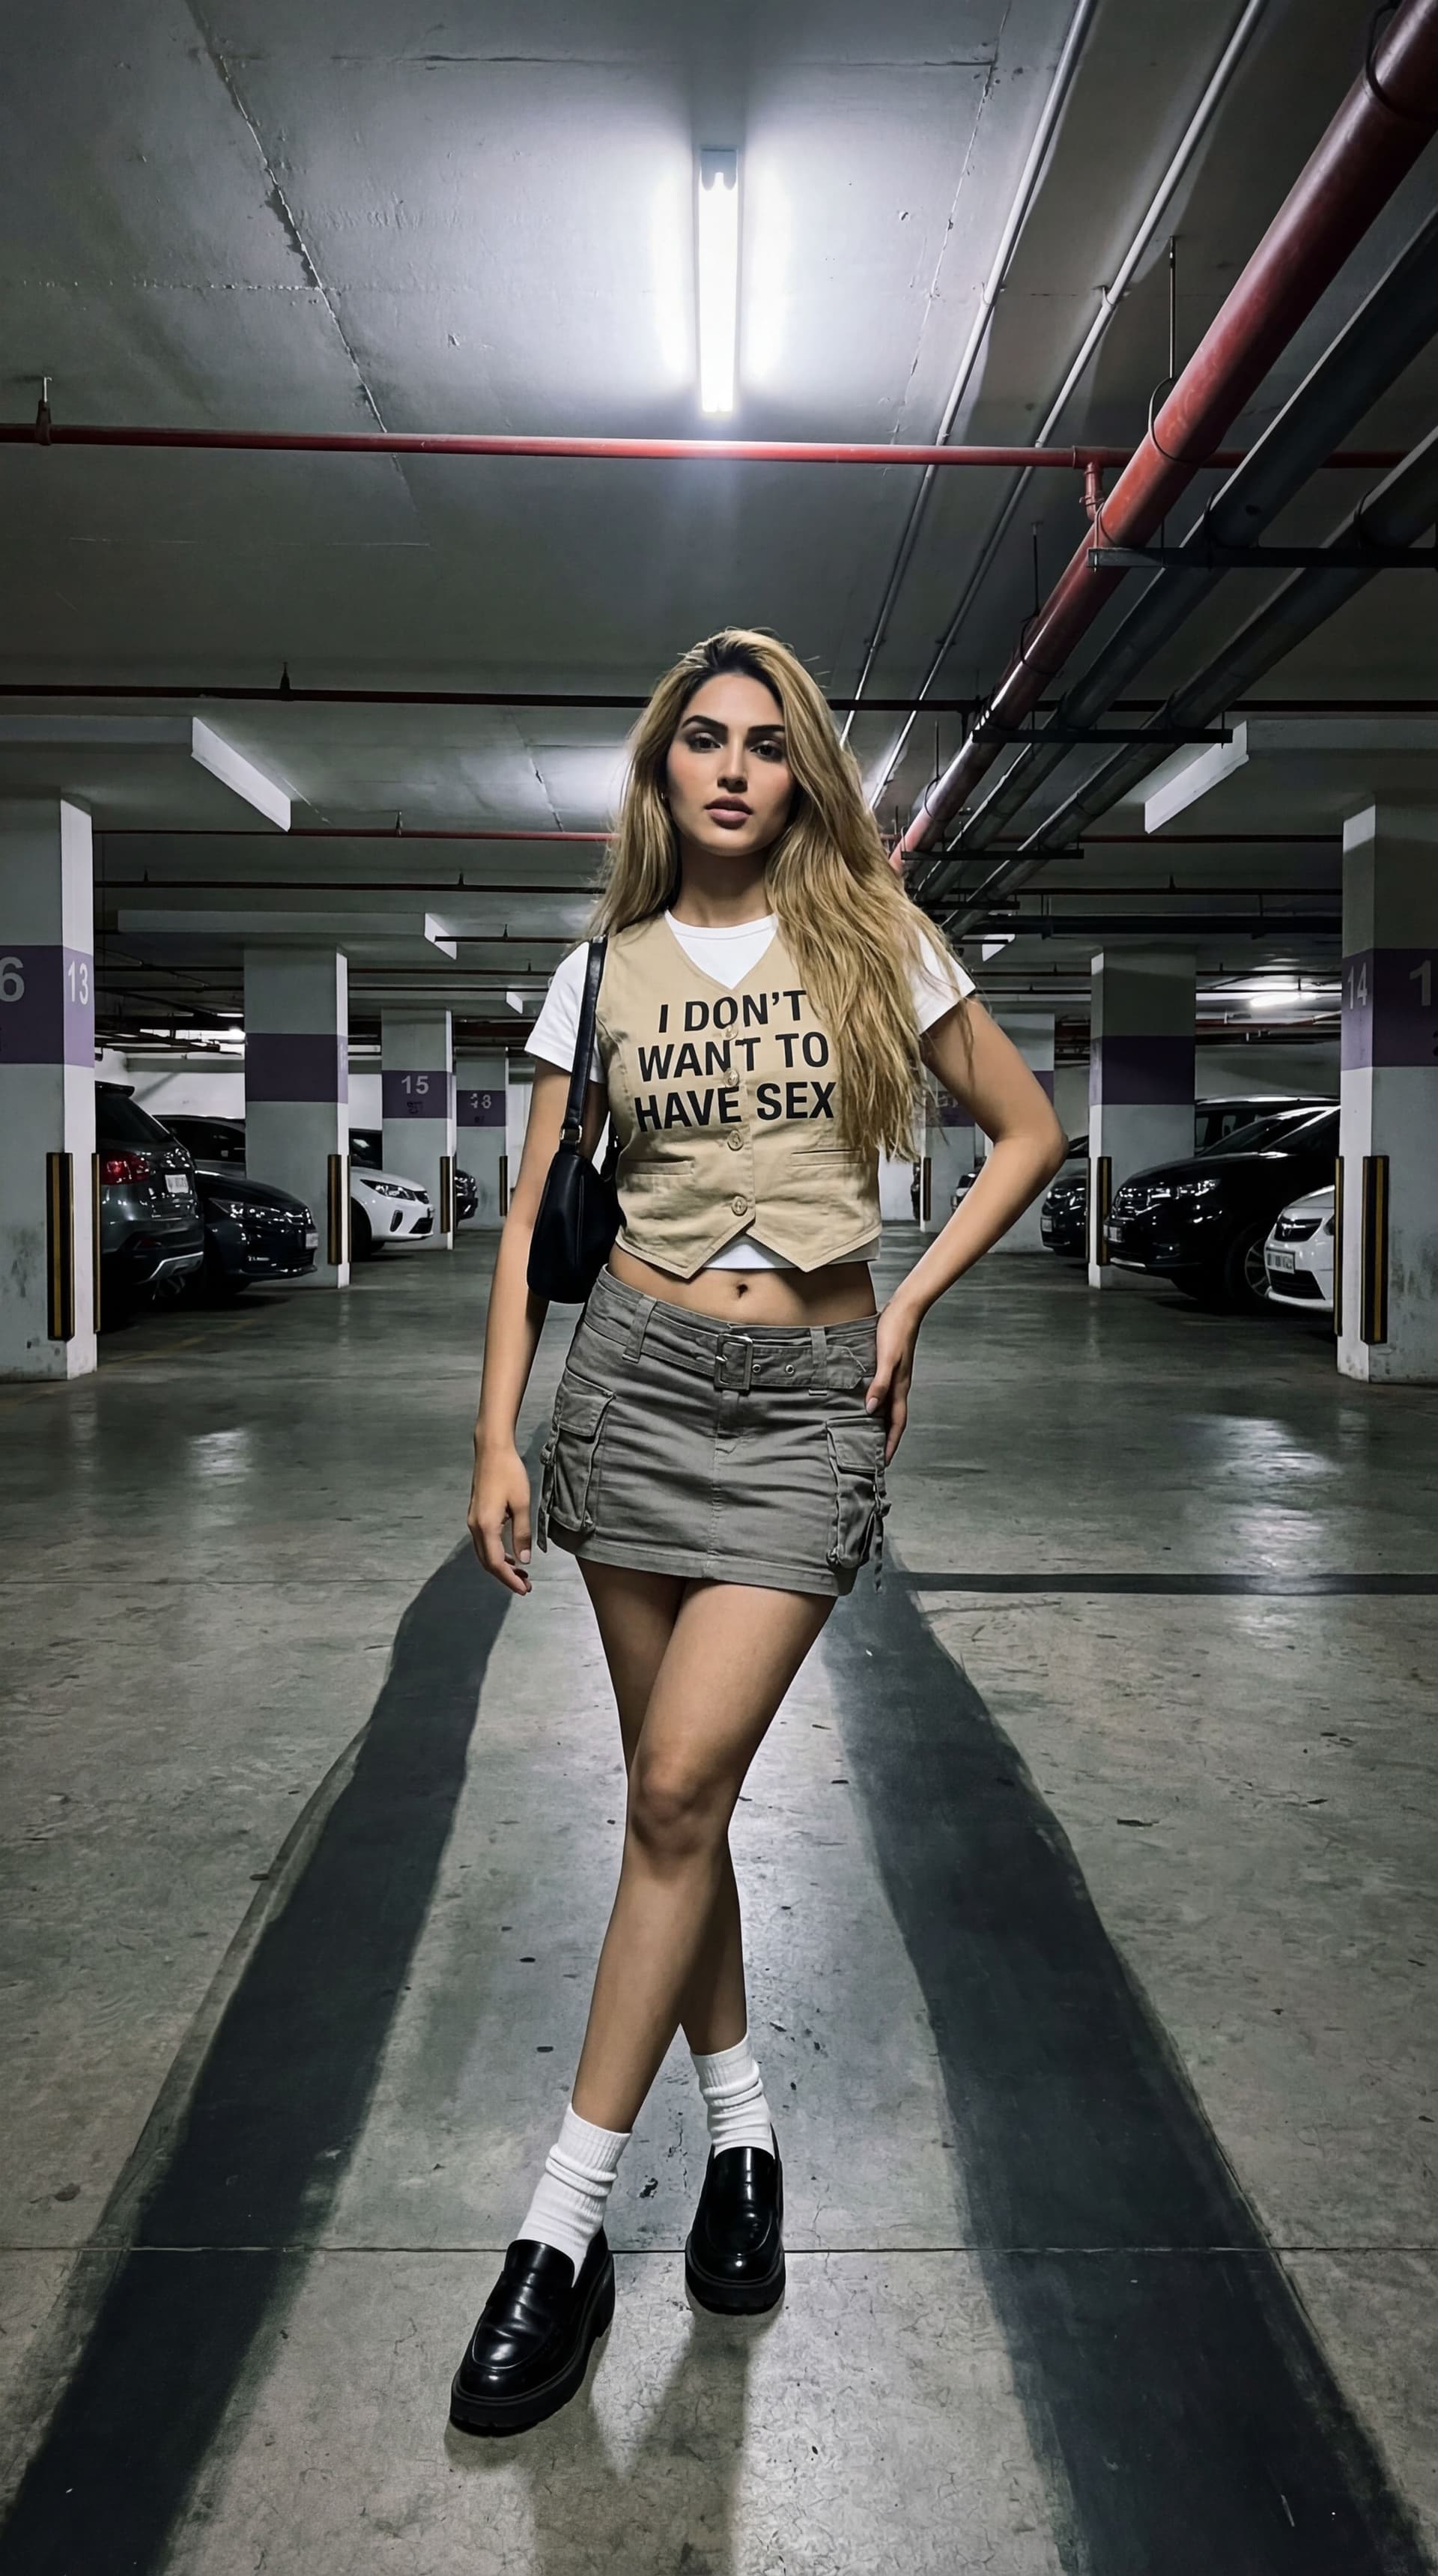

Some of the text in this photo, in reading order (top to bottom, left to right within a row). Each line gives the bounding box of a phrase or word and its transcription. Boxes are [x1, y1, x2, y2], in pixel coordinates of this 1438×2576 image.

[0, 956, 25, 1002] 6
[67, 961, 88, 1005] 13
[1347, 962, 1368, 1009] 14
[658, 989, 807, 1033] I DON’T
[637, 1031, 829, 1083] WANT TO
[401, 1075, 429, 1095] 15
[634, 1081, 837, 1133] HAVE SEX
